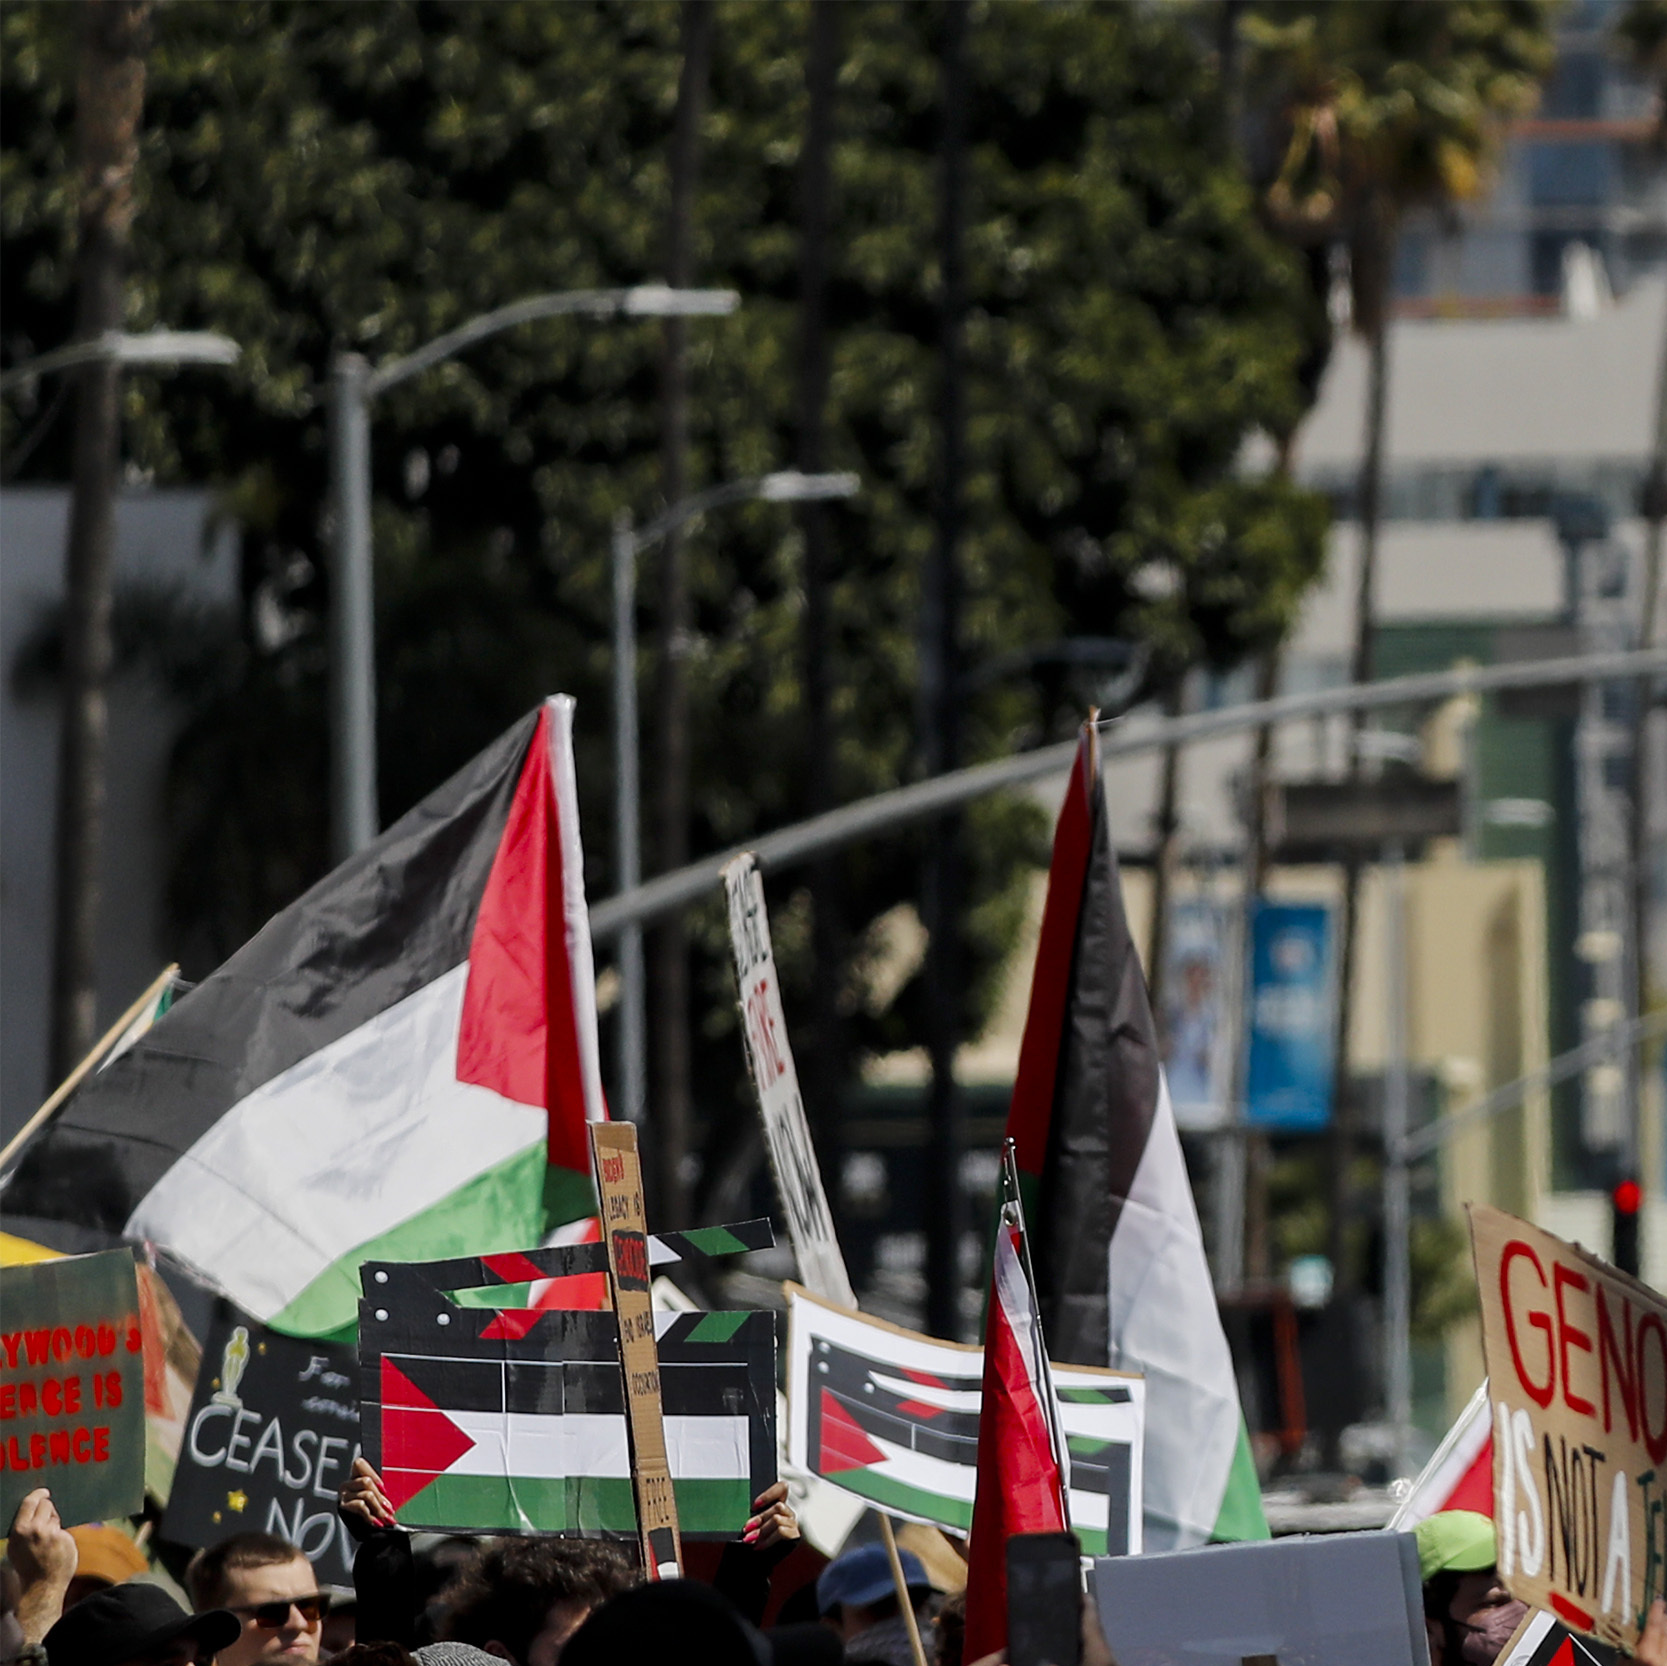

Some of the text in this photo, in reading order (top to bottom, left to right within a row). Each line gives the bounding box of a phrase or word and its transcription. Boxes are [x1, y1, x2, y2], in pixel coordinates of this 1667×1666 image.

[93, 1371, 123, 1409] IS
[1499, 1401, 1545, 1578] IS
[1543, 1431, 1606, 1600] NOT
[1600, 1469, 1632, 1627] A
